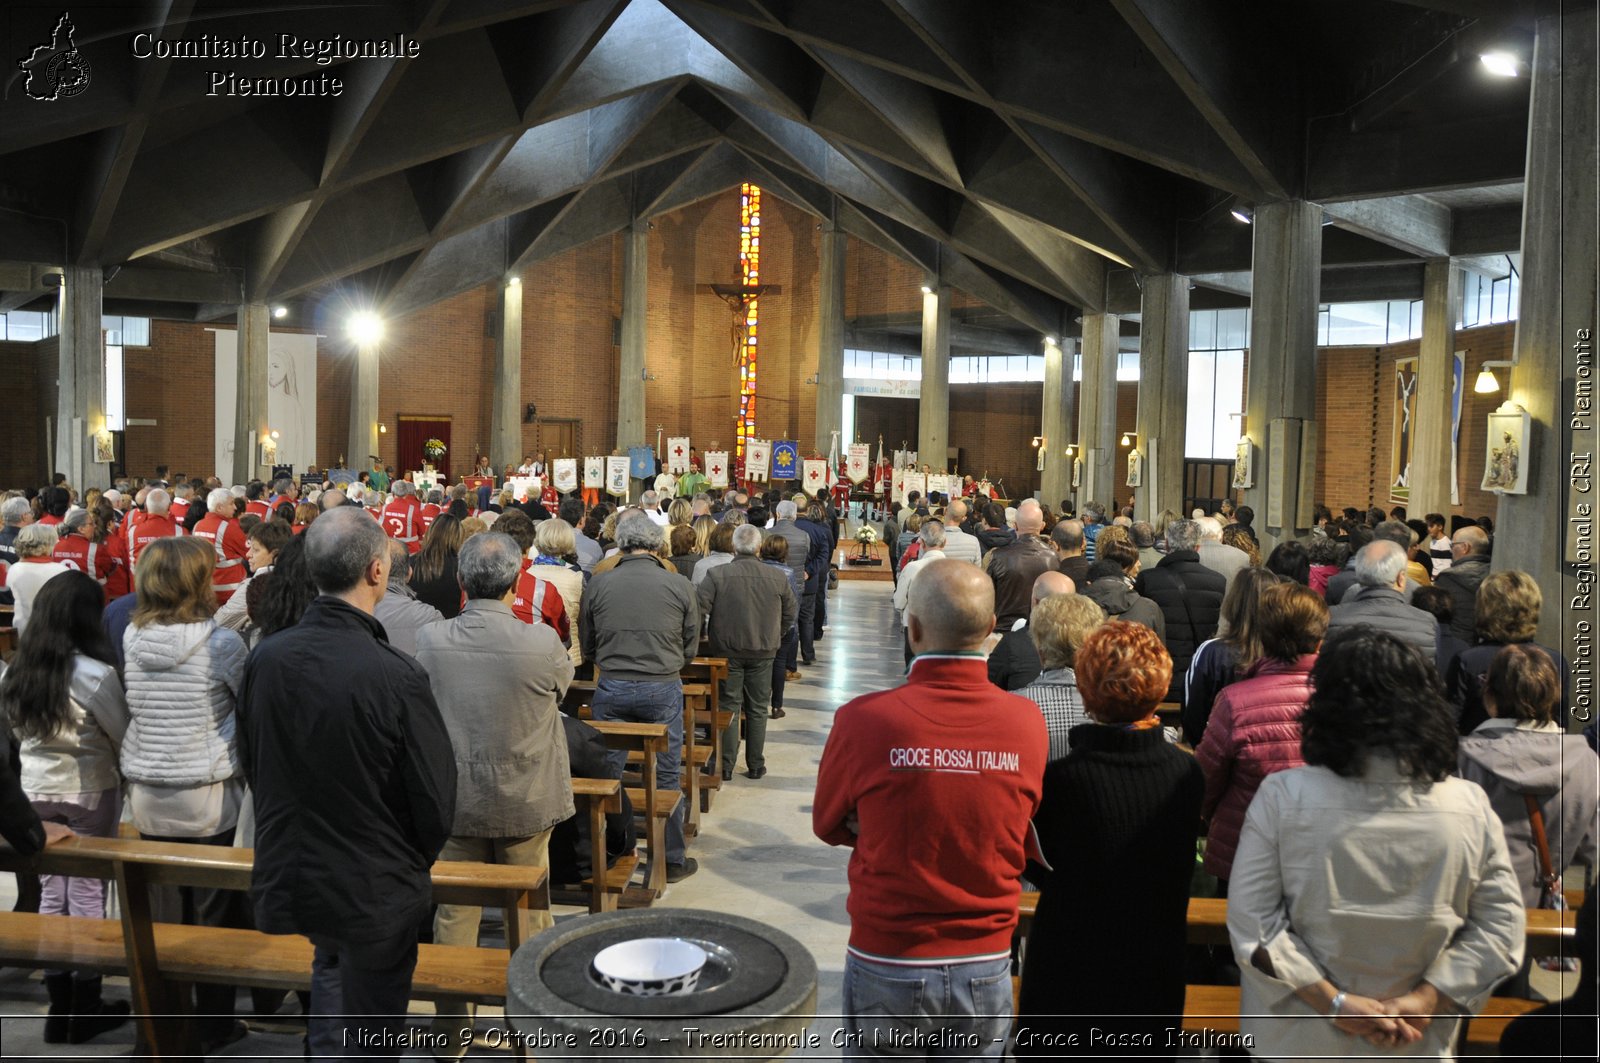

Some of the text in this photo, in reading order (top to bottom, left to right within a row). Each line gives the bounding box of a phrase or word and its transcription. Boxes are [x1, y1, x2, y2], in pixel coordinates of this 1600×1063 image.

[889, 747, 1020, 772] CROCE ROSSA ITALIANA
